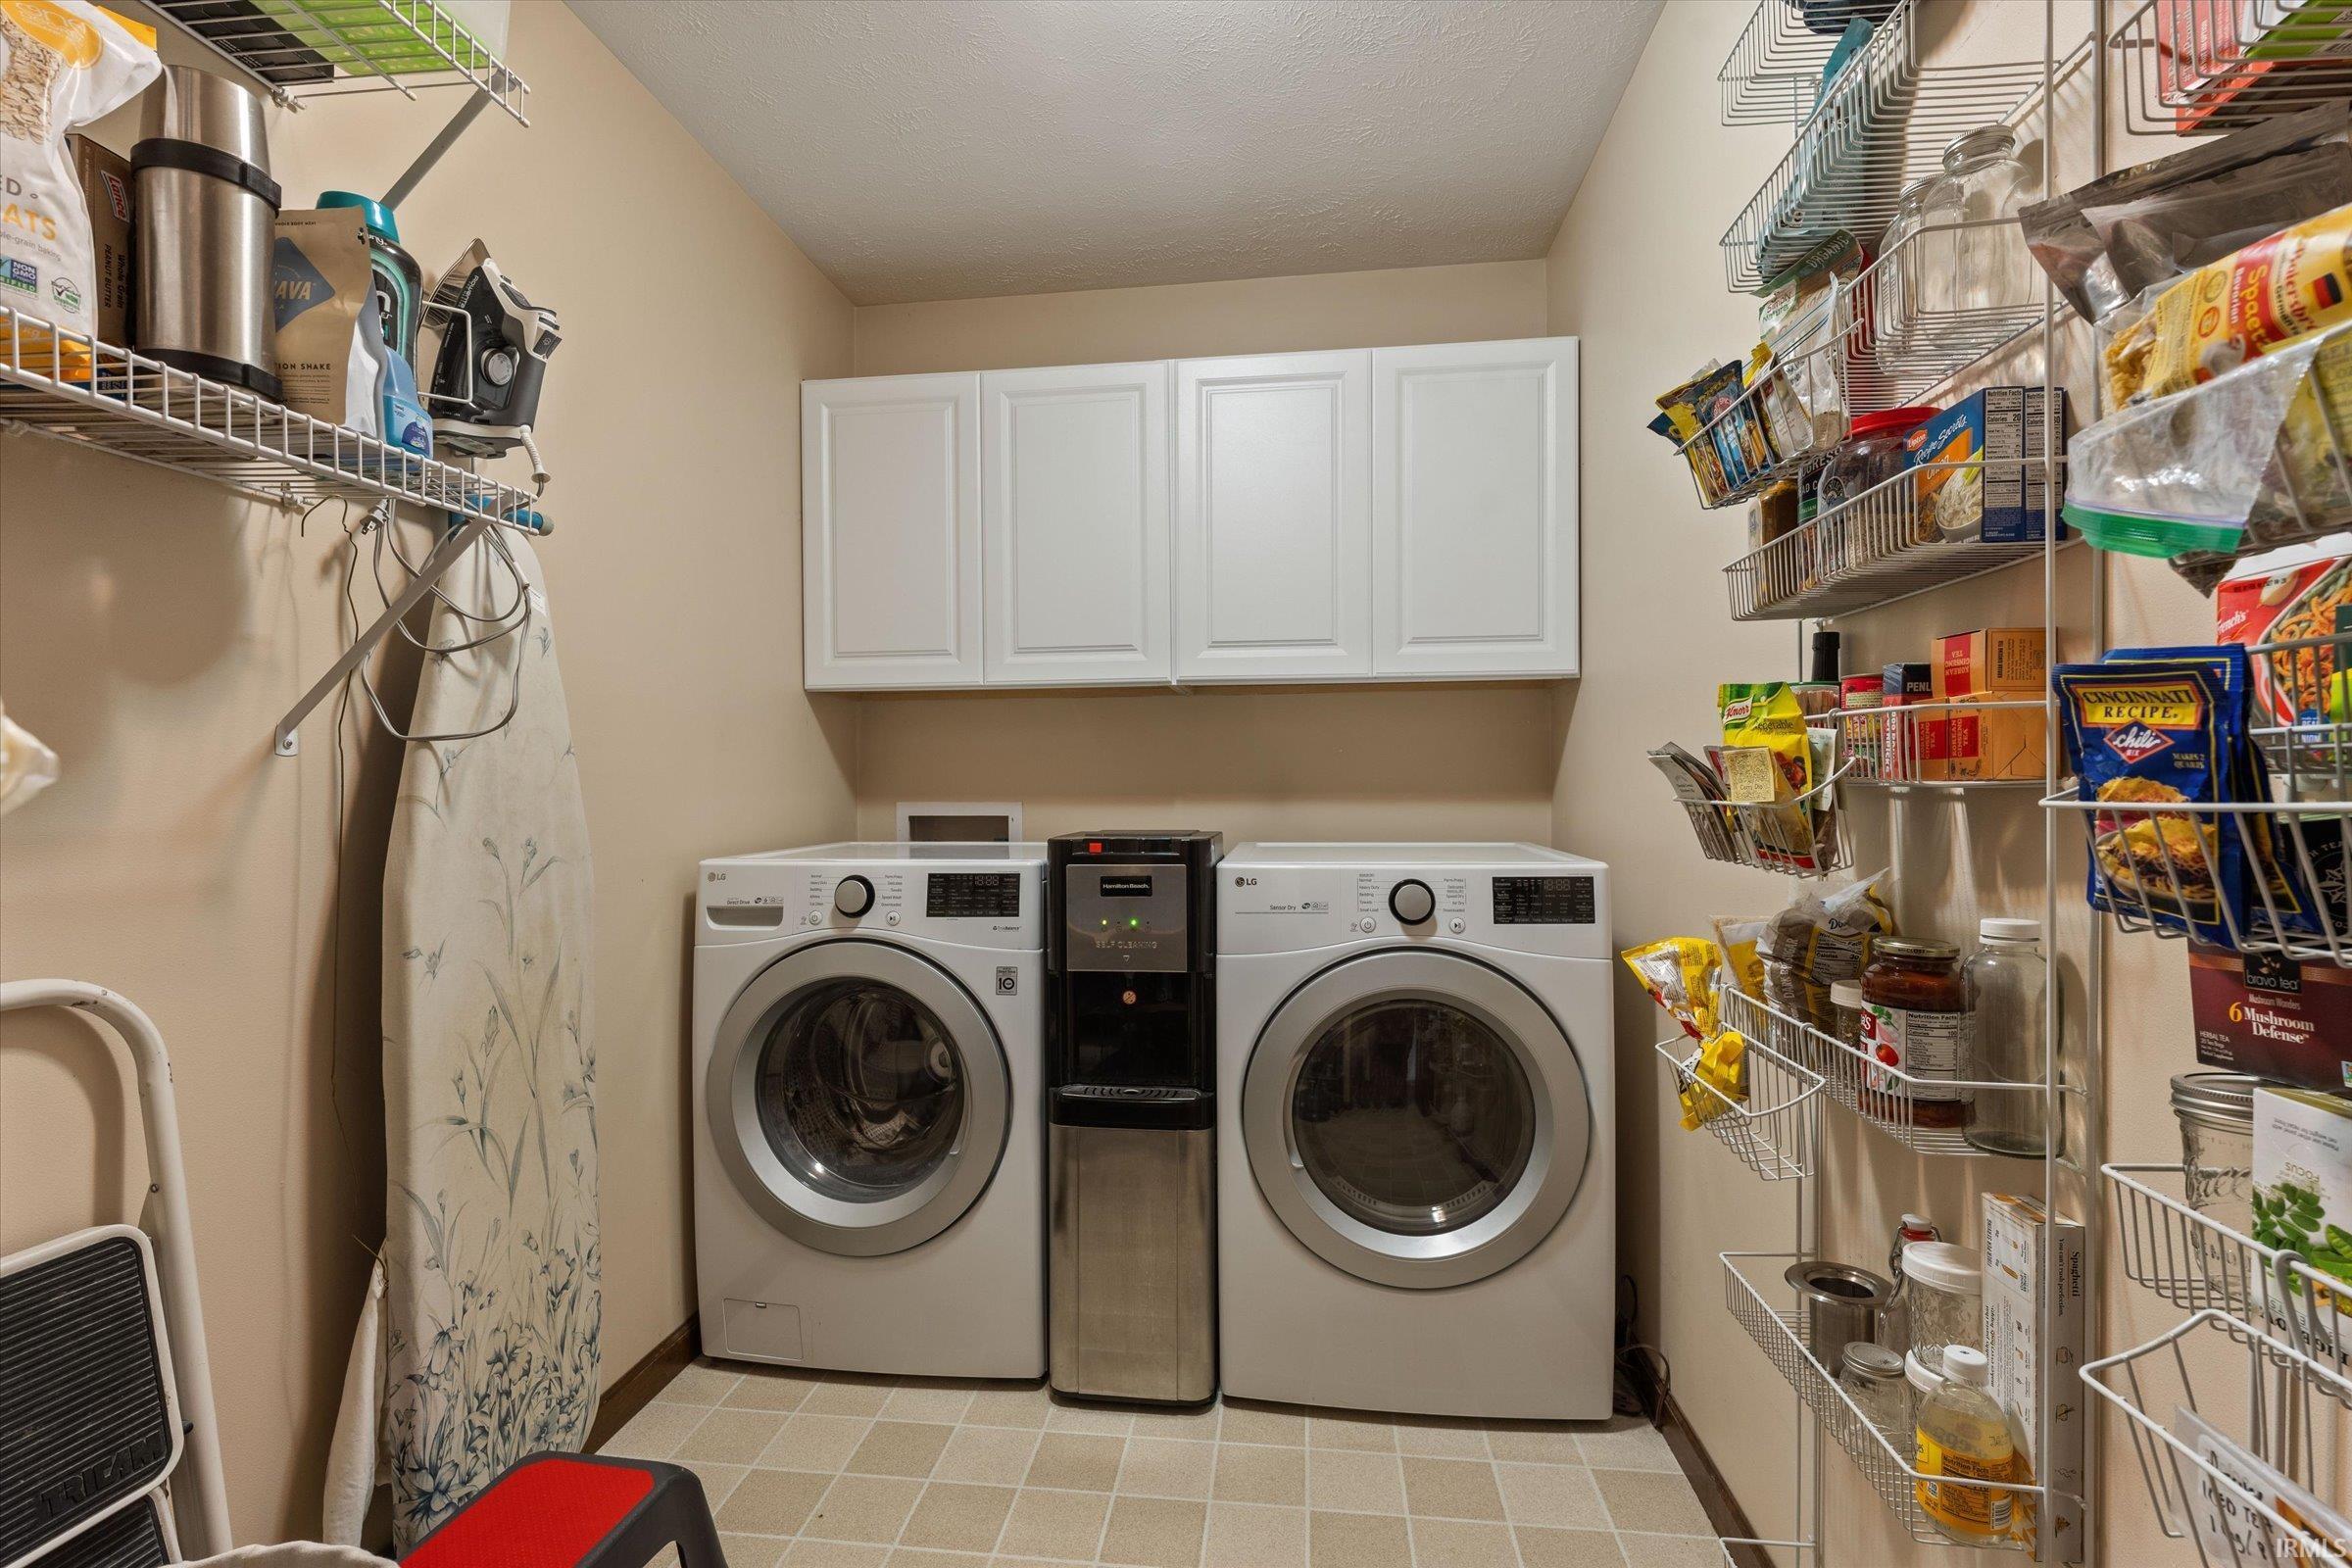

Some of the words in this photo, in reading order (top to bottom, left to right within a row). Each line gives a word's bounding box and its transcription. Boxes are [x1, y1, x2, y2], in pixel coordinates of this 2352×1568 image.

[109, 175, 126, 220] Lance
[104, 244, 113, 273] PEANUT
[13, 262, 36, 274] NON
[13, 269, 36, 280] GMO
[117, 254, 126, 282] Whole
[104, 275, 113, 309] BUTTER
[117, 282, 126, 310] Grain
[2012, 413, 2022, 422] 20
[1907, 432, 1928, 448] Lipton
[1913, 439, 1944, 466] Recipe
[1937, 413, 1968, 443] Secrets
[1951, 650, 1965, 659] TEA
[1944, 665, 1971, 676] KOREAN
[2082, 689, 2197, 705] CINCINNATI
[1725, 705, 1750, 719] Knorr
[2113, 725, 2162, 750] chili
[2172, 752, 2199, 760] MAKES
[2174, 760, 2205, 770] QUARTS
[998, 977, 1015, 990] 10
[2245, 970, 2277, 988] bravo
[2278, 975, 2299, 991] tea
[2248, 993, 2276, 1006] Mushroom
[2275, 997, 2301, 1010] Wonders
[2229, 1002, 2242, 1022] 6
[2243, 1006, 2315, 1032] Mushroom
[2199, 1030, 2219, 1042] HERBAL
[2218, 1033, 2230, 1043] TEA
[2284, 1161, 2321, 1184] FOCUS
[2071, 1250, 2081, 1298] Spaghetti
[1943, 1455, 1972, 1471] Nutrition
[1972, 1465, 1989, 1474] Facts
